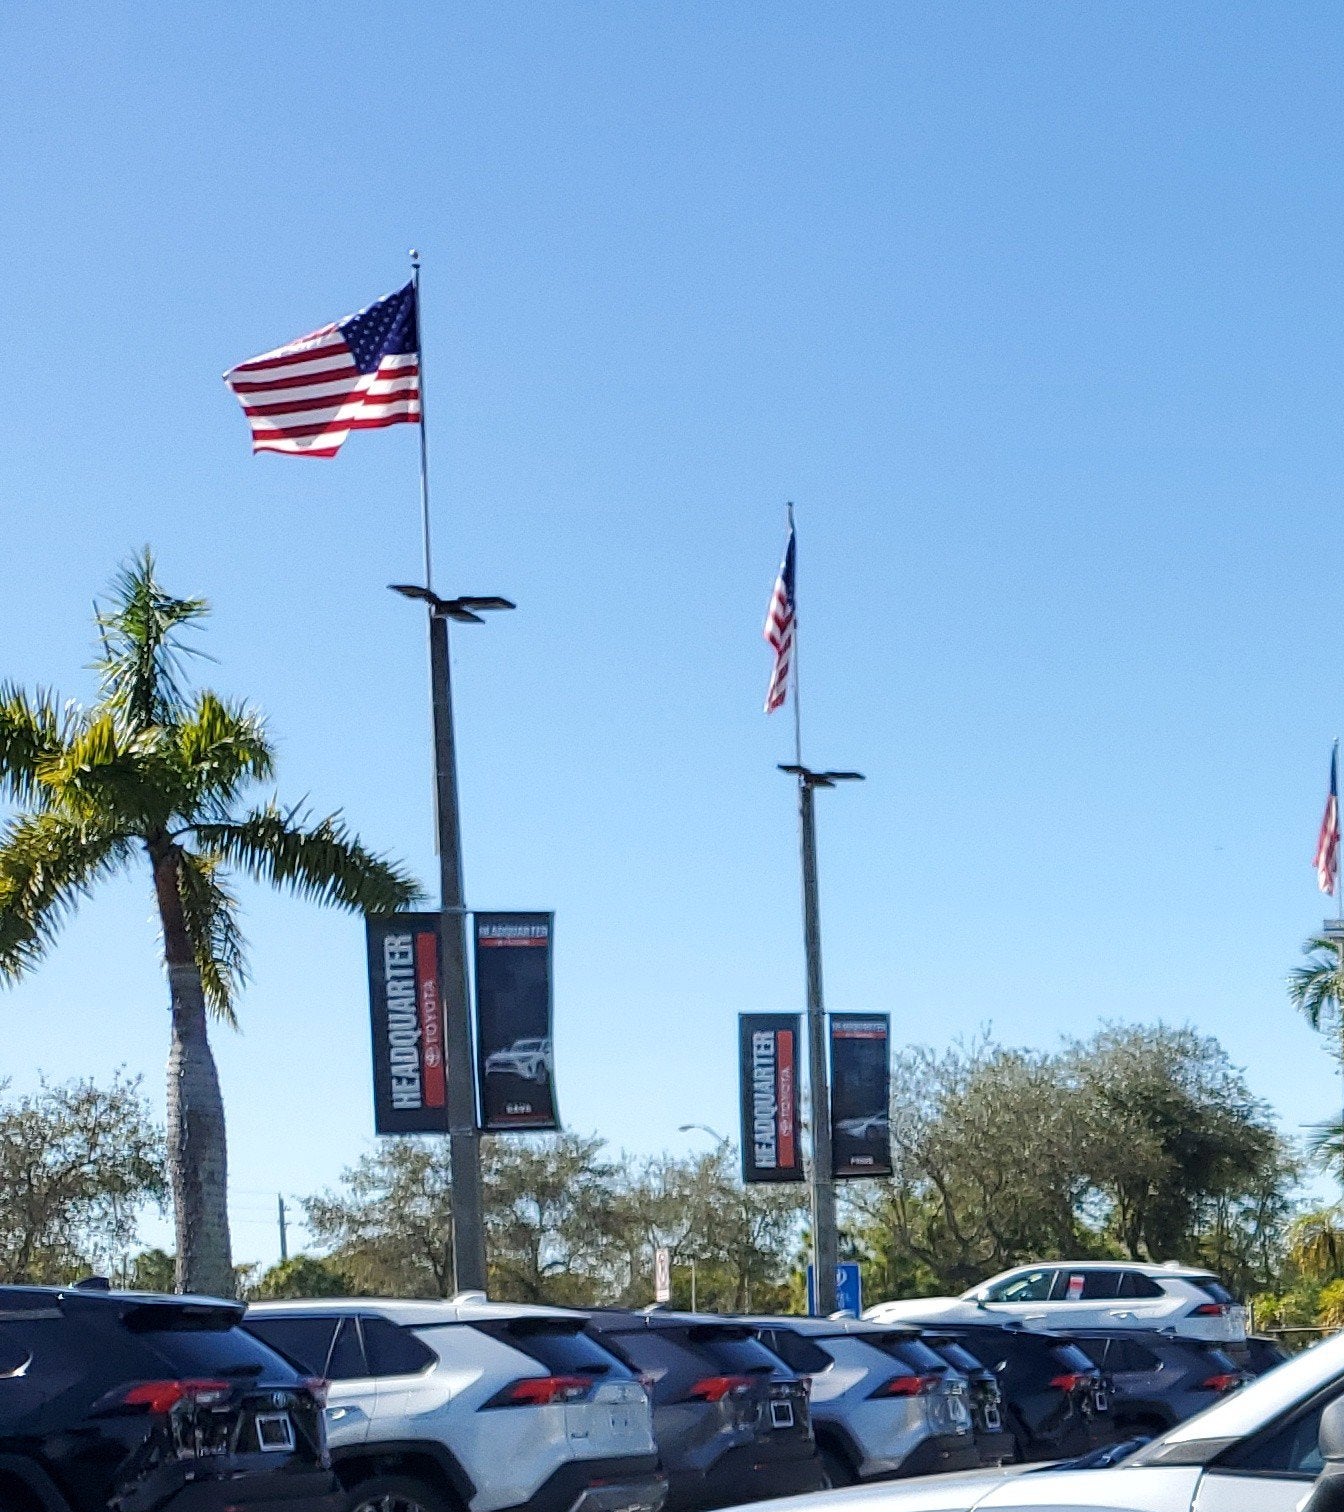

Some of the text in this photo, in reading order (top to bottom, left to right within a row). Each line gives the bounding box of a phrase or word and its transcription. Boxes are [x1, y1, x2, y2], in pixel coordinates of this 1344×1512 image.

[383, 932, 423, 1109] HEADQUARTER
[422, 979, 439, 1046] TOYOTA
[752, 1030, 777, 1168] HEADQUARTER
